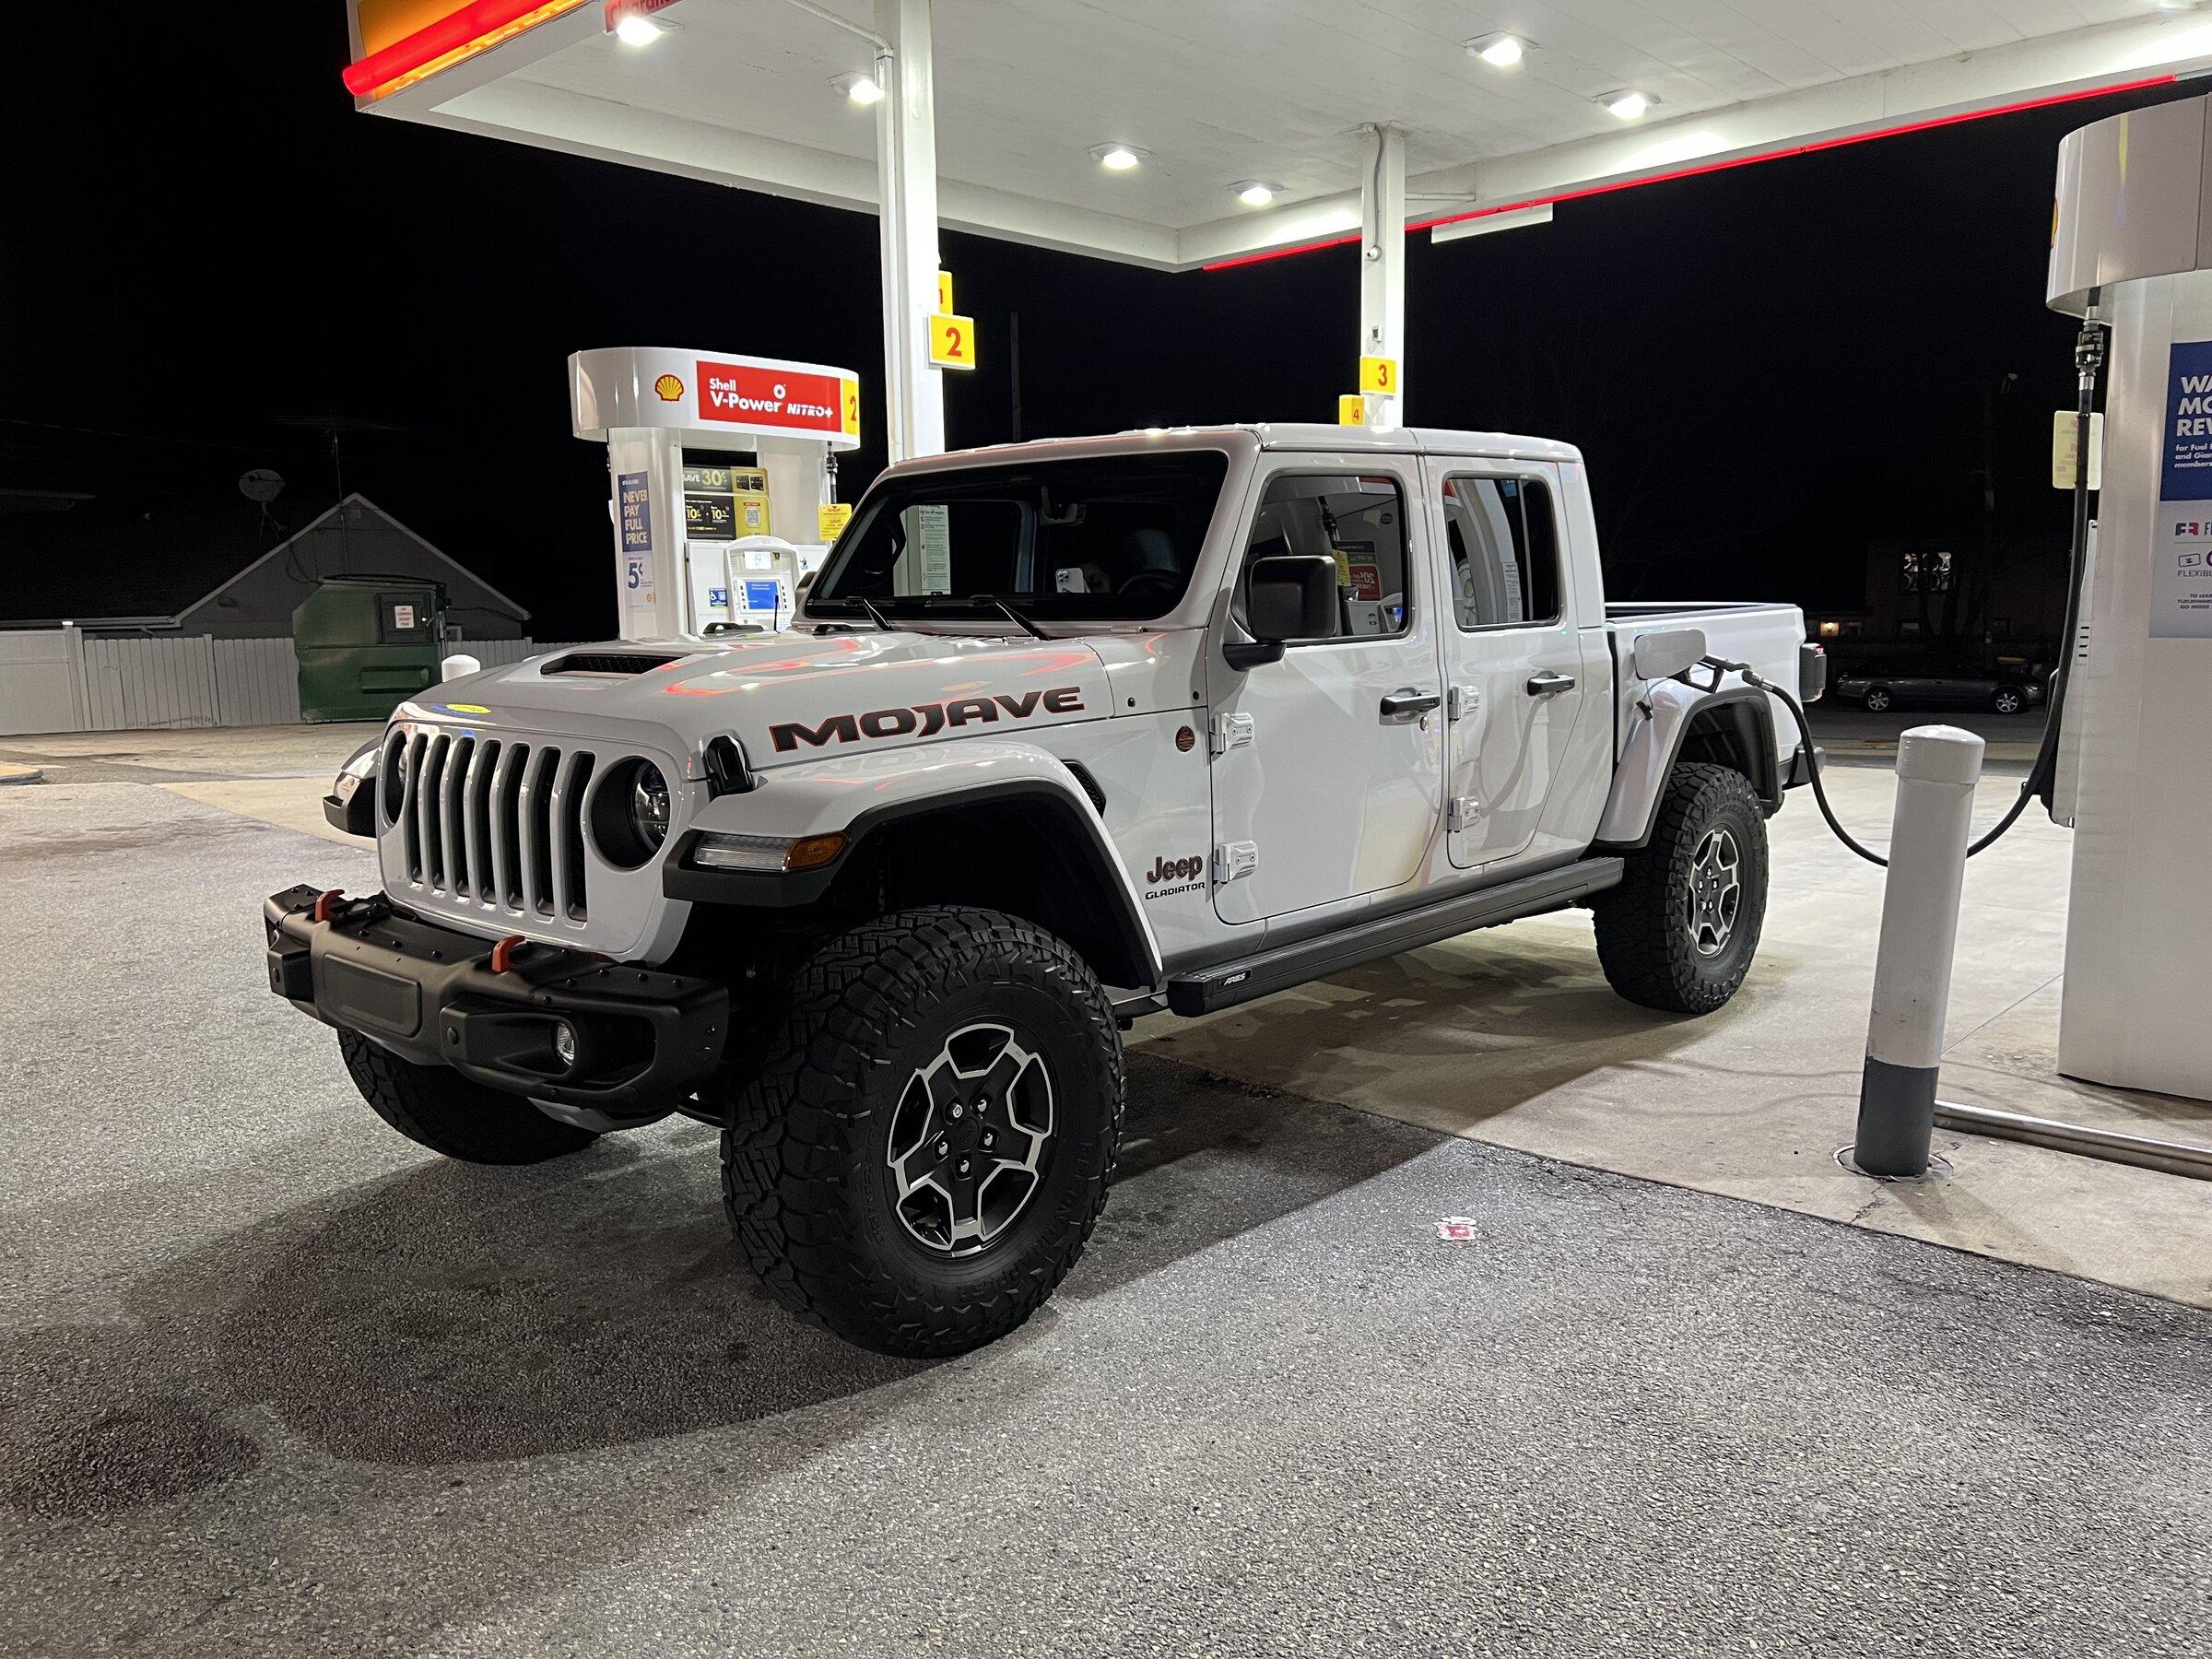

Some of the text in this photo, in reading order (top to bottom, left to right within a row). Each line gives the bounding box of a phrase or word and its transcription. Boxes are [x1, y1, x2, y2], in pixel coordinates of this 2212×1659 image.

[946, 327, 962, 357] 2
[1378, 364, 1388, 386] 3
[2181, 375, 2212, 394] W
[709, 378, 736, 392] Shell
[710, 391, 782, 413] V-Power
[850, 395, 857, 421] 2
[2178, 396, 2212, 415] M
[1353, 408, 1359, 421] 4
[2176, 418, 2212, 437] RE
[682, 474, 700, 482] SAVE
[623, 489, 649, 504] NEVER
[624, 504, 640, 517] PAY
[625, 518, 643, 531] FULL
[626, 532, 647, 545] PRICE
[769, 687, 1085, 752] MOJAVE
[1147, 856, 1203, 883] Jeep
[1146, 882, 1206, 900] GLADIATOR
